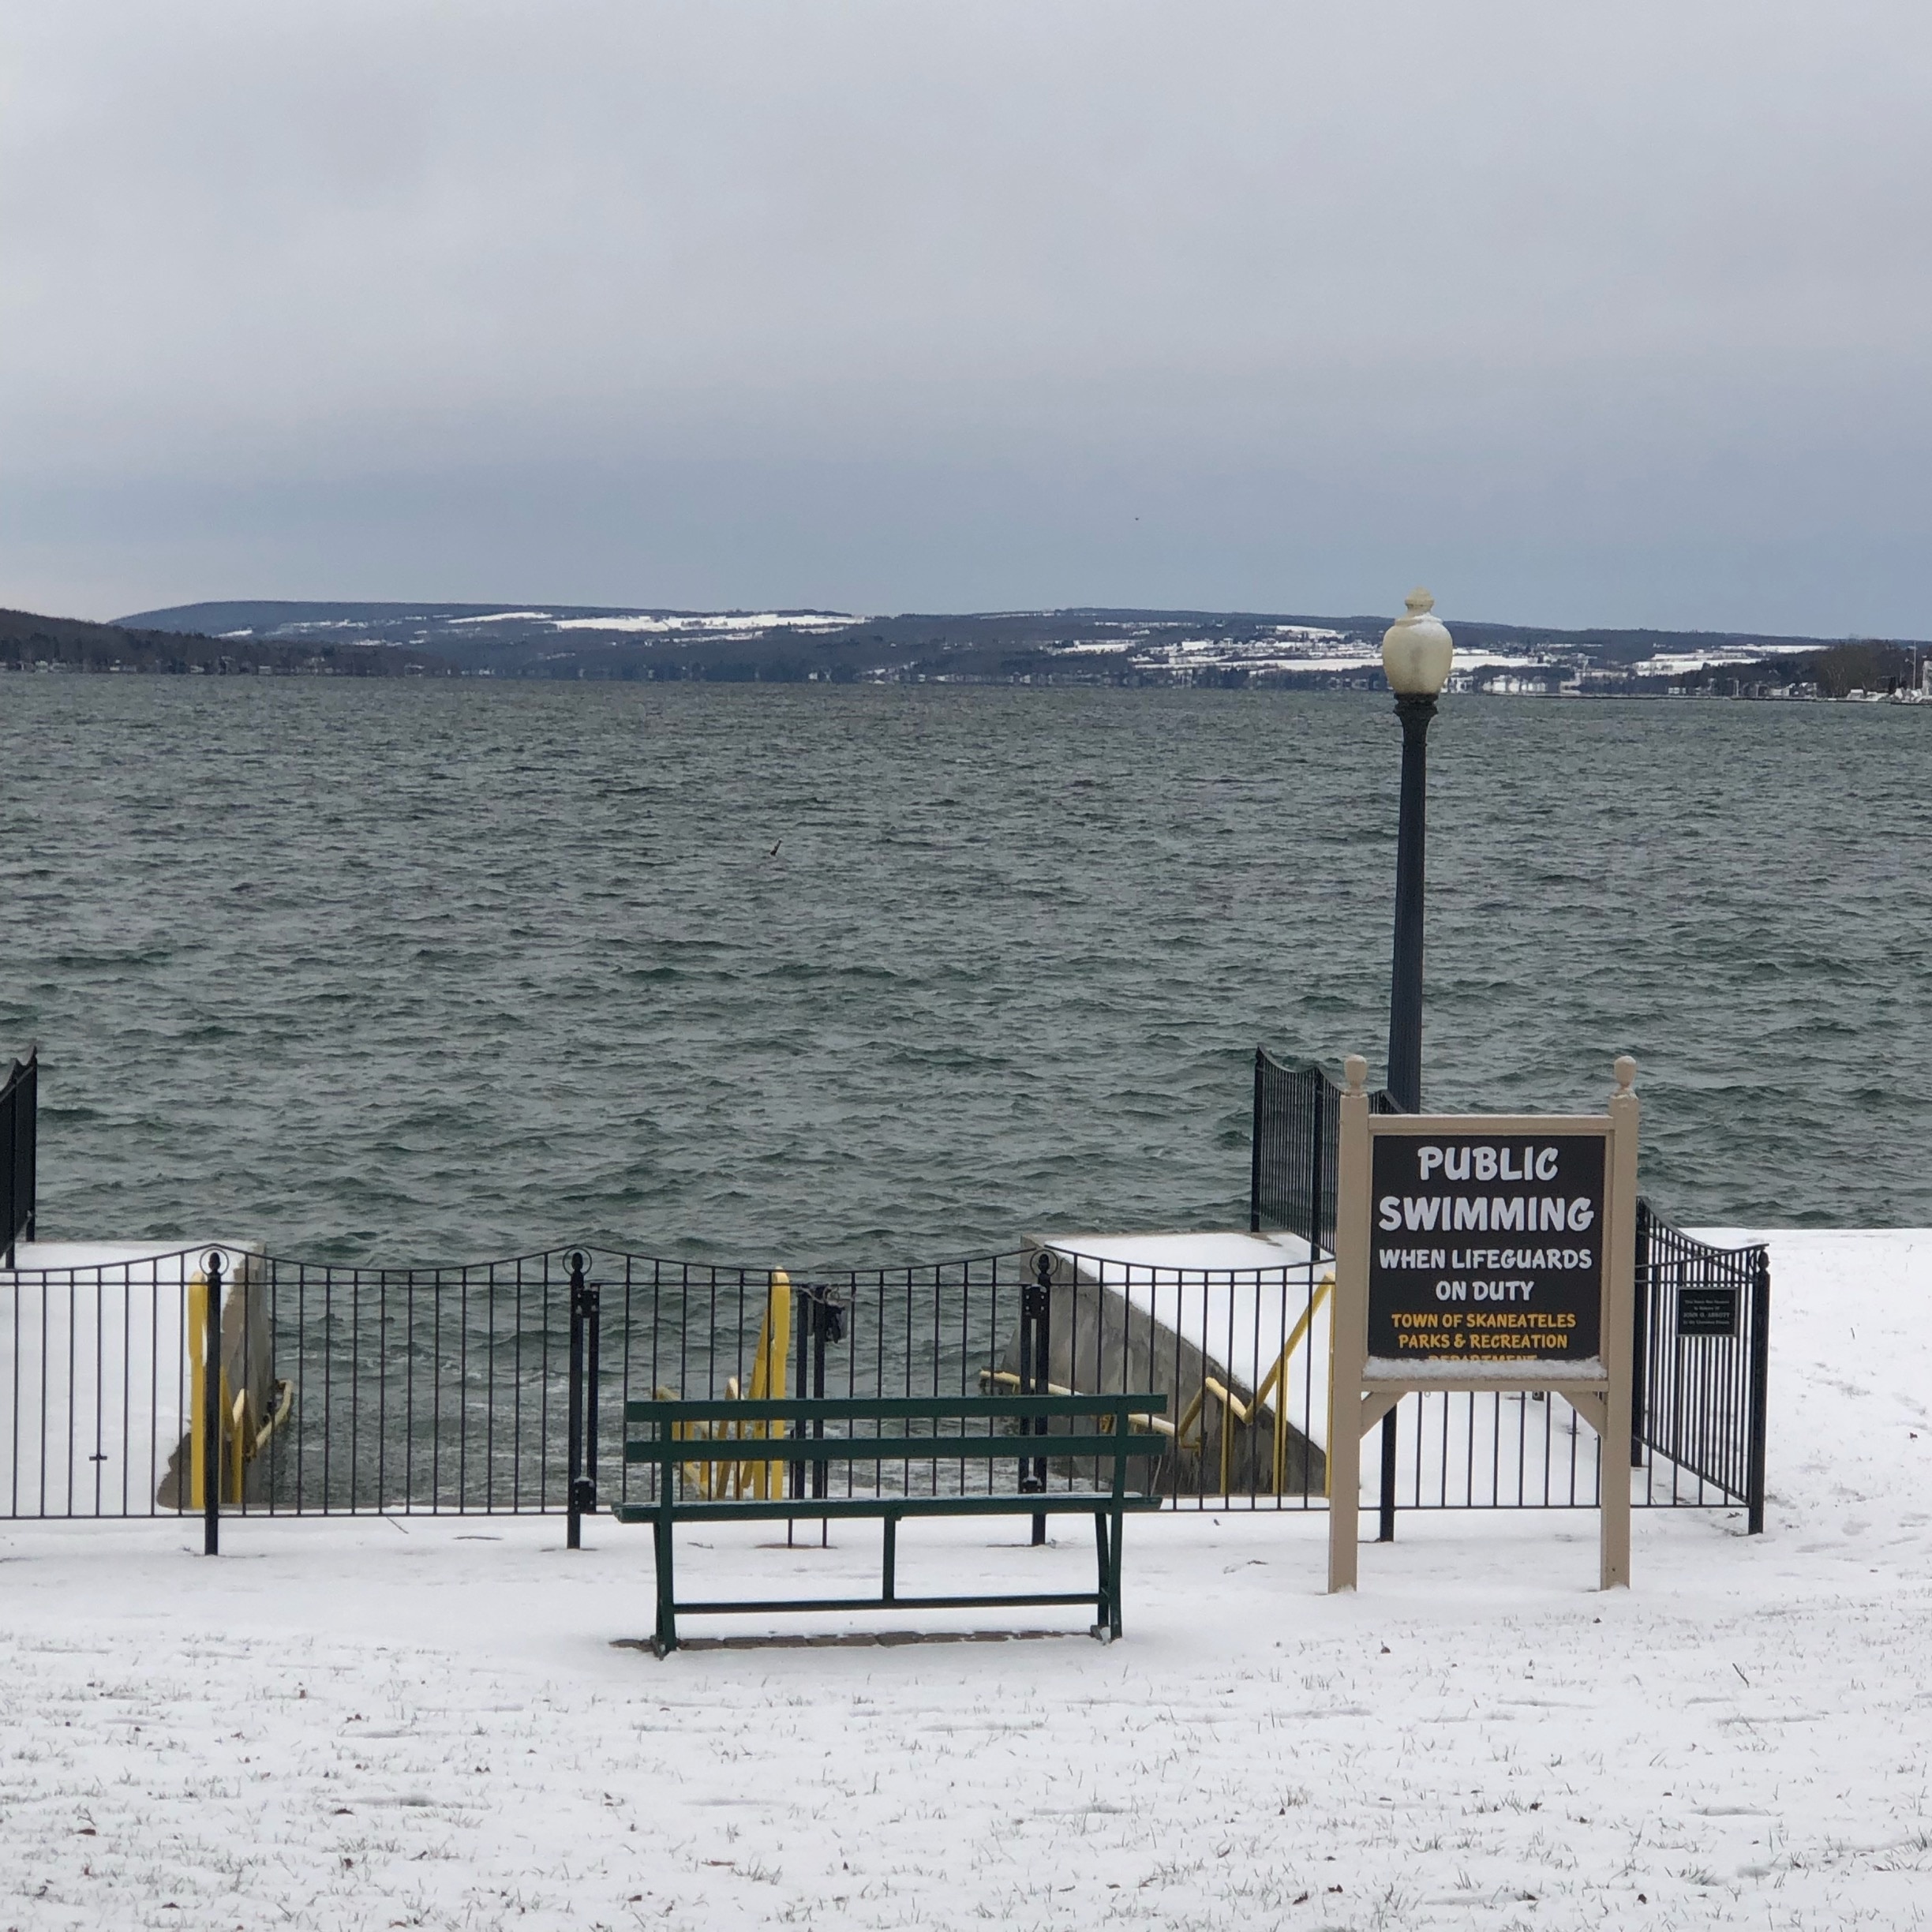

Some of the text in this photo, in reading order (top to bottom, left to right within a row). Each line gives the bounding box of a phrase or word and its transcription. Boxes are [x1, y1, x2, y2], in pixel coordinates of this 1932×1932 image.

[1417, 1146, 1559, 1181] PUBLIC
[1378, 1196, 1595, 1232] SWIMMING
[1379, 1248, 1593, 1270] WHEN LIFEGUARDS
[1435, 1280, 1535, 1301] ON DUTY
[1391, 1312, 1577, 1327] TOWN OF SKANEATELES
[1398, 1333, 1568, 1349] PARKS & RECREATION
